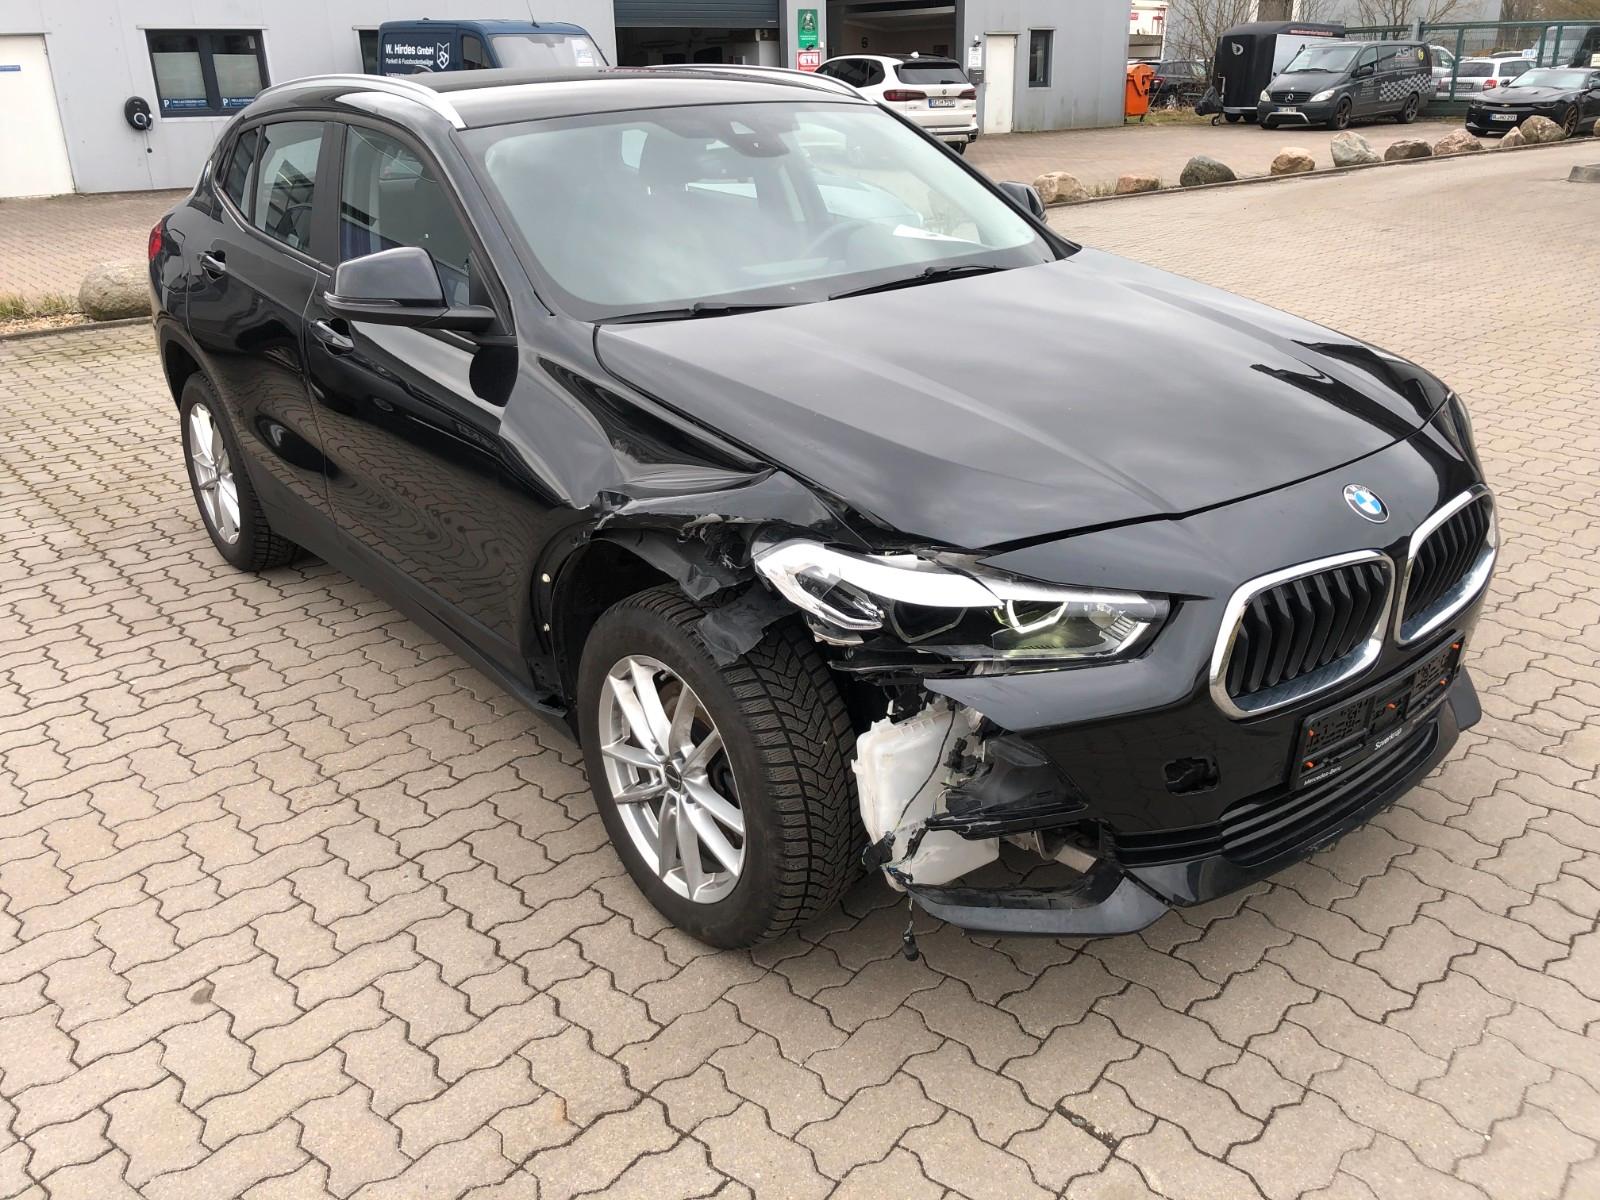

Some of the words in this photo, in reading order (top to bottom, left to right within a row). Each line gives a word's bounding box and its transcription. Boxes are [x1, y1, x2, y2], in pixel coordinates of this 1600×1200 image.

[385, 43, 393, 54] W.
[394, 43, 416, 55] Hirdes
[416, 46, 434, 55] GmbH
